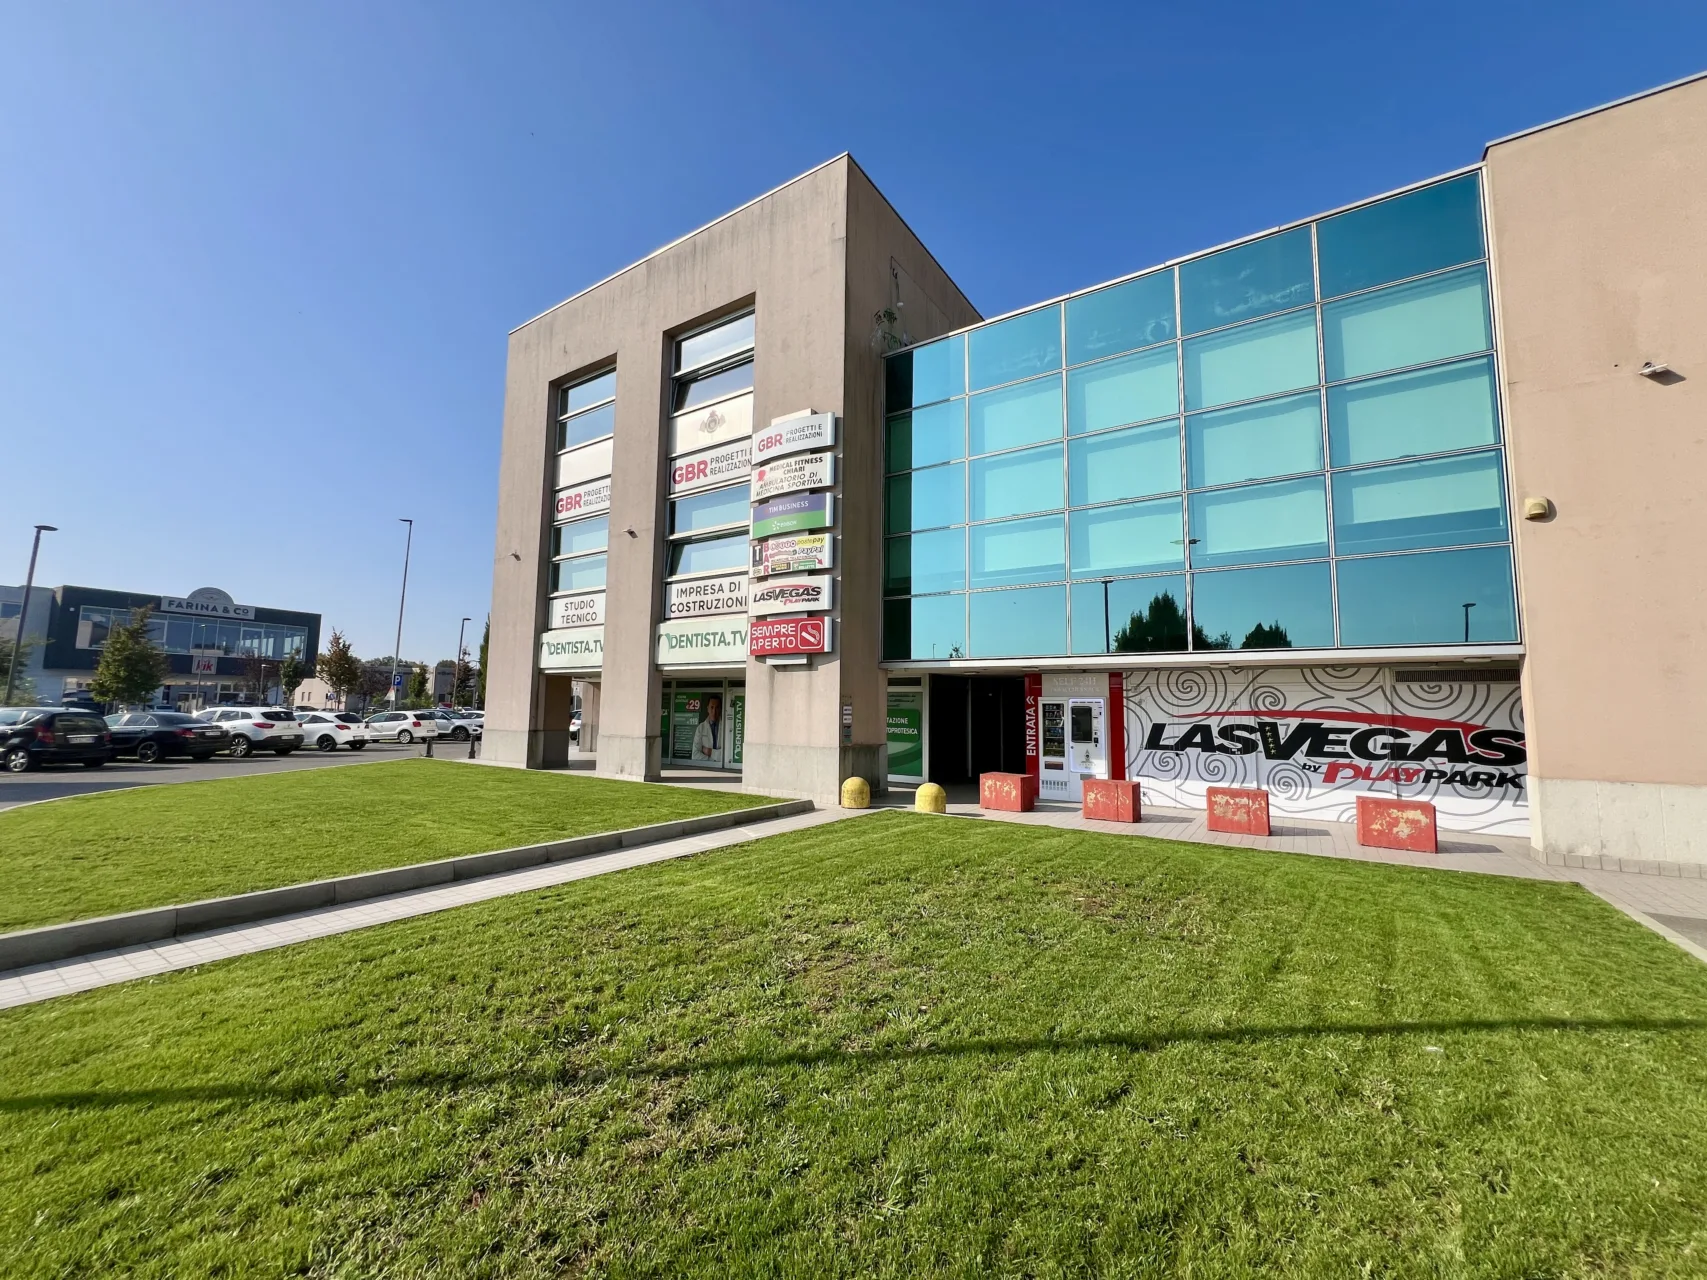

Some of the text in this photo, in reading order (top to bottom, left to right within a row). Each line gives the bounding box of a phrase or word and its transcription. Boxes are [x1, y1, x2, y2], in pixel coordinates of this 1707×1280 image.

[758, 433, 783, 452] GBR
[786, 425, 816, 436] PROGETTI
[786, 432, 822, 444] REALIZZAZIONI
[672, 460, 708, 484] GBR
[710, 448, 746, 466] PROGETTI
[770, 456, 823, 472] MEDICAL FITNESS
[783, 466, 805, 475] CHIARI
[756, 478, 822, 497] MEDICINA SPORTIVA
[760, 474, 805, 489] AMBULATORIO
[556, 493, 582, 514] GBR
[779, 501, 808, 509] BUSINESS
[798, 545, 824, 555] PayPal
[677, 581, 740, 598] IMPRESA DI
[168, 600, 218, 612] FARINA
[564, 599, 594, 612] STUDIO
[670, 596, 747, 613] COSTRUZIONI
[561, 612, 597, 624] TECNICO
[752, 624, 796, 638] SEMPRE
[670, 630, 747, 649] DENTISTA.TV
[751, 637, 796, 650] APERTO
[395, 676, 400, 684] P
[1054, 677, 1076, 686] SELF
[1026, 707, 1036, 756] ENTRATA
[1302, 762, 1320, 772] by
